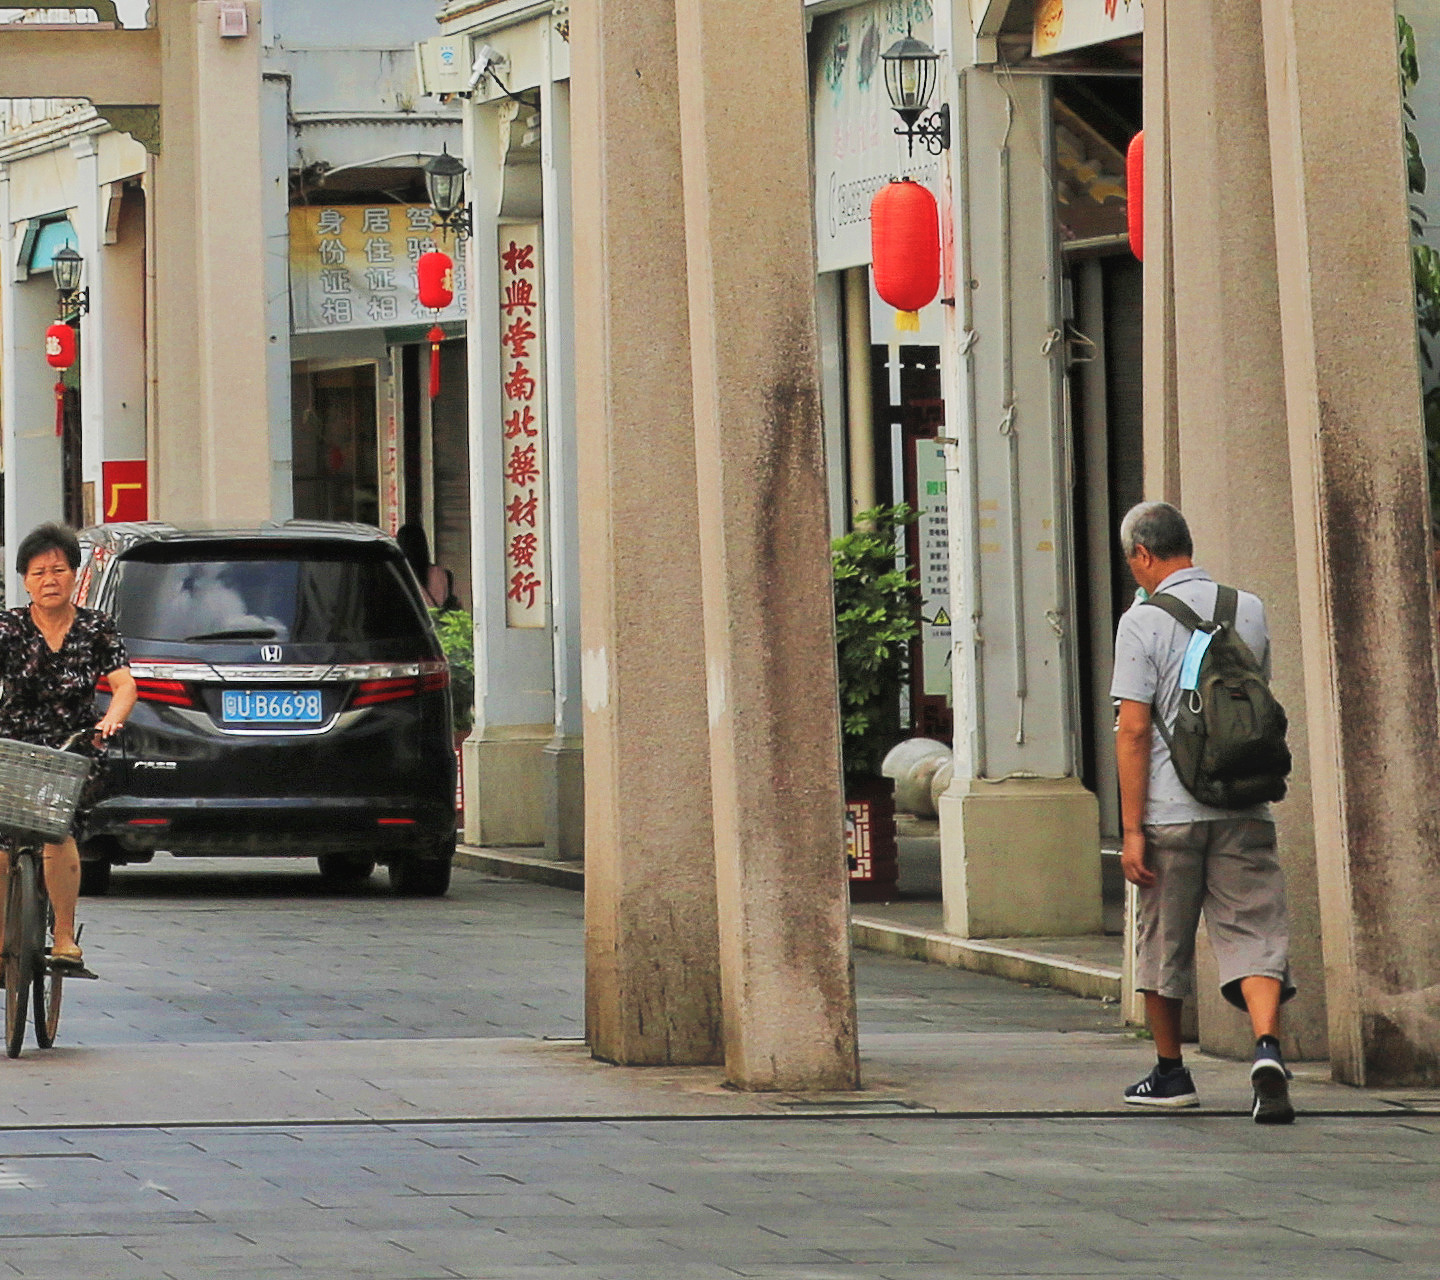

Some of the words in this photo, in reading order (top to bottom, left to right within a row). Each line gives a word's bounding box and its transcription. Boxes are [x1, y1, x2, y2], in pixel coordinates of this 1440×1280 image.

[317, 208, 352, 324] 身份证相
[362, 208, 397, 321] 居住证相
